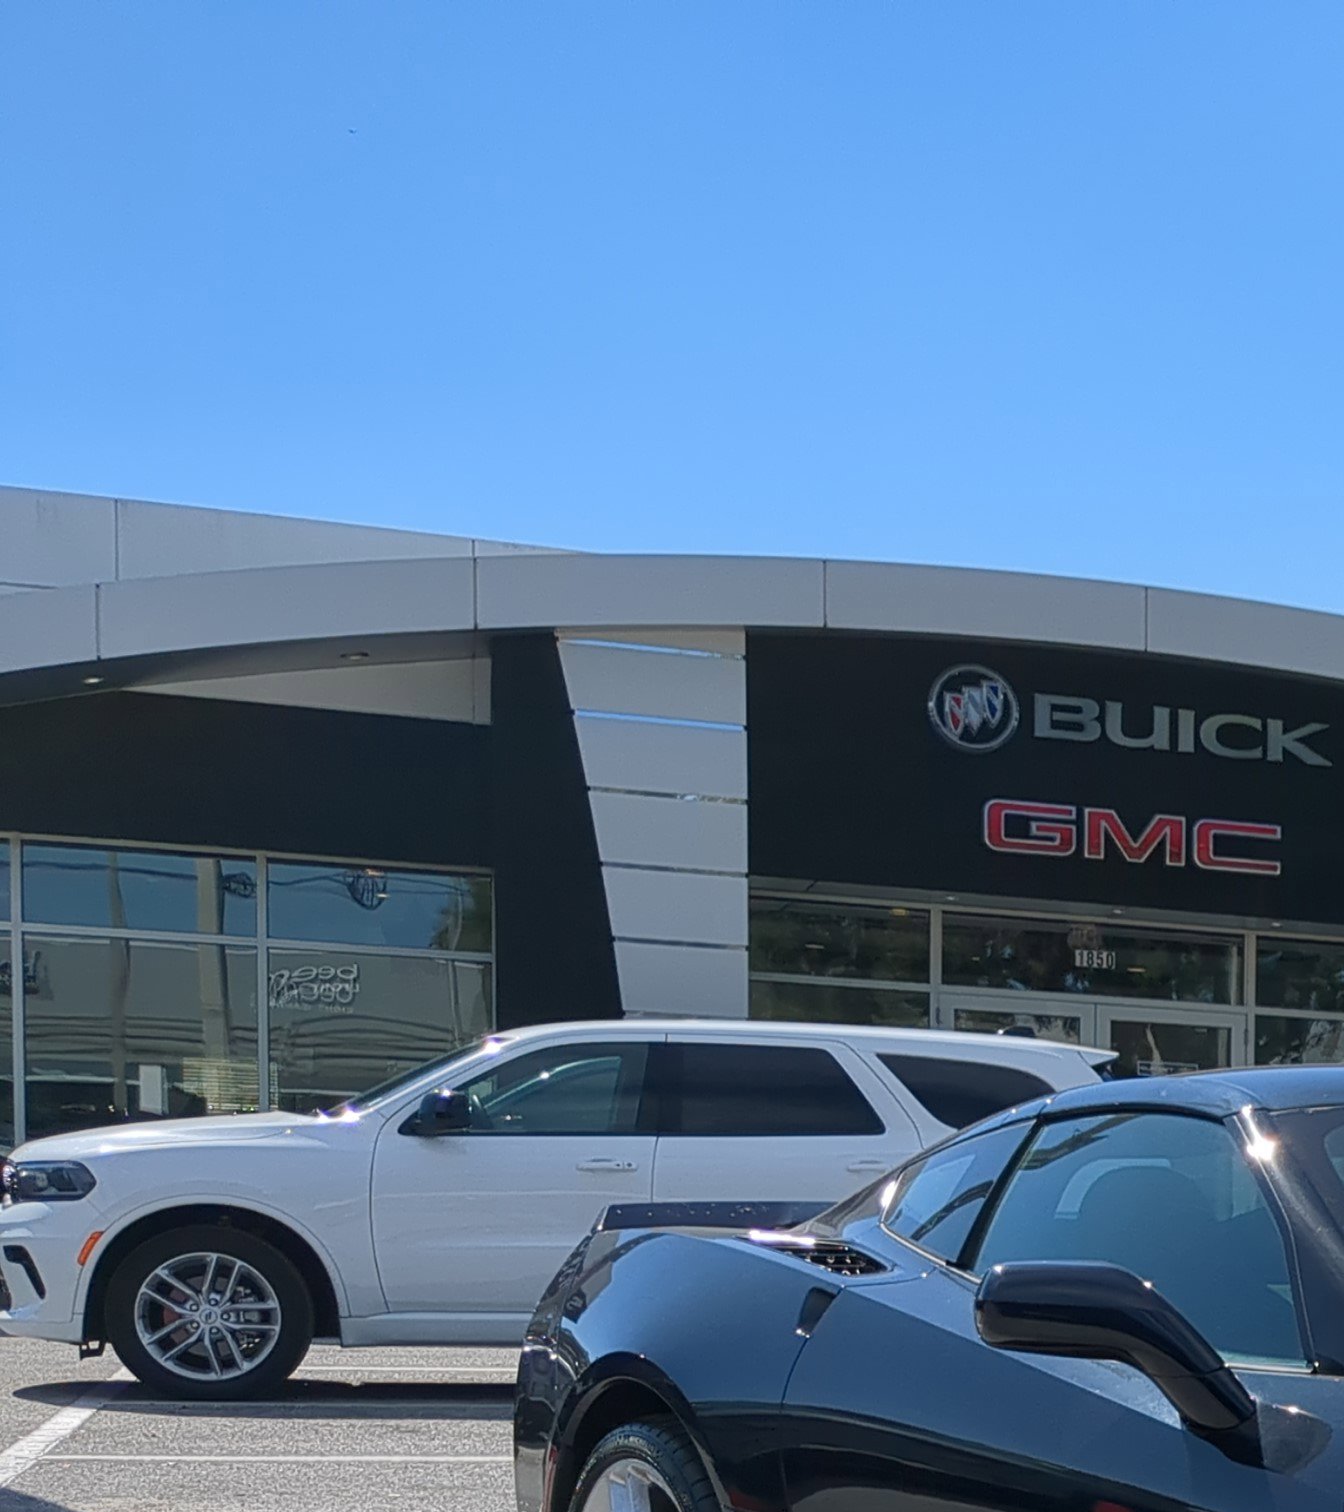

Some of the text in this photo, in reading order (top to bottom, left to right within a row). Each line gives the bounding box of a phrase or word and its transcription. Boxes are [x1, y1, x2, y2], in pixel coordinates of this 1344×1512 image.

[1033, 692, 1333, 767] BUICK
[984, 798, 1282, 875] GMC
[1075, 950, 1116, 969] 1850
